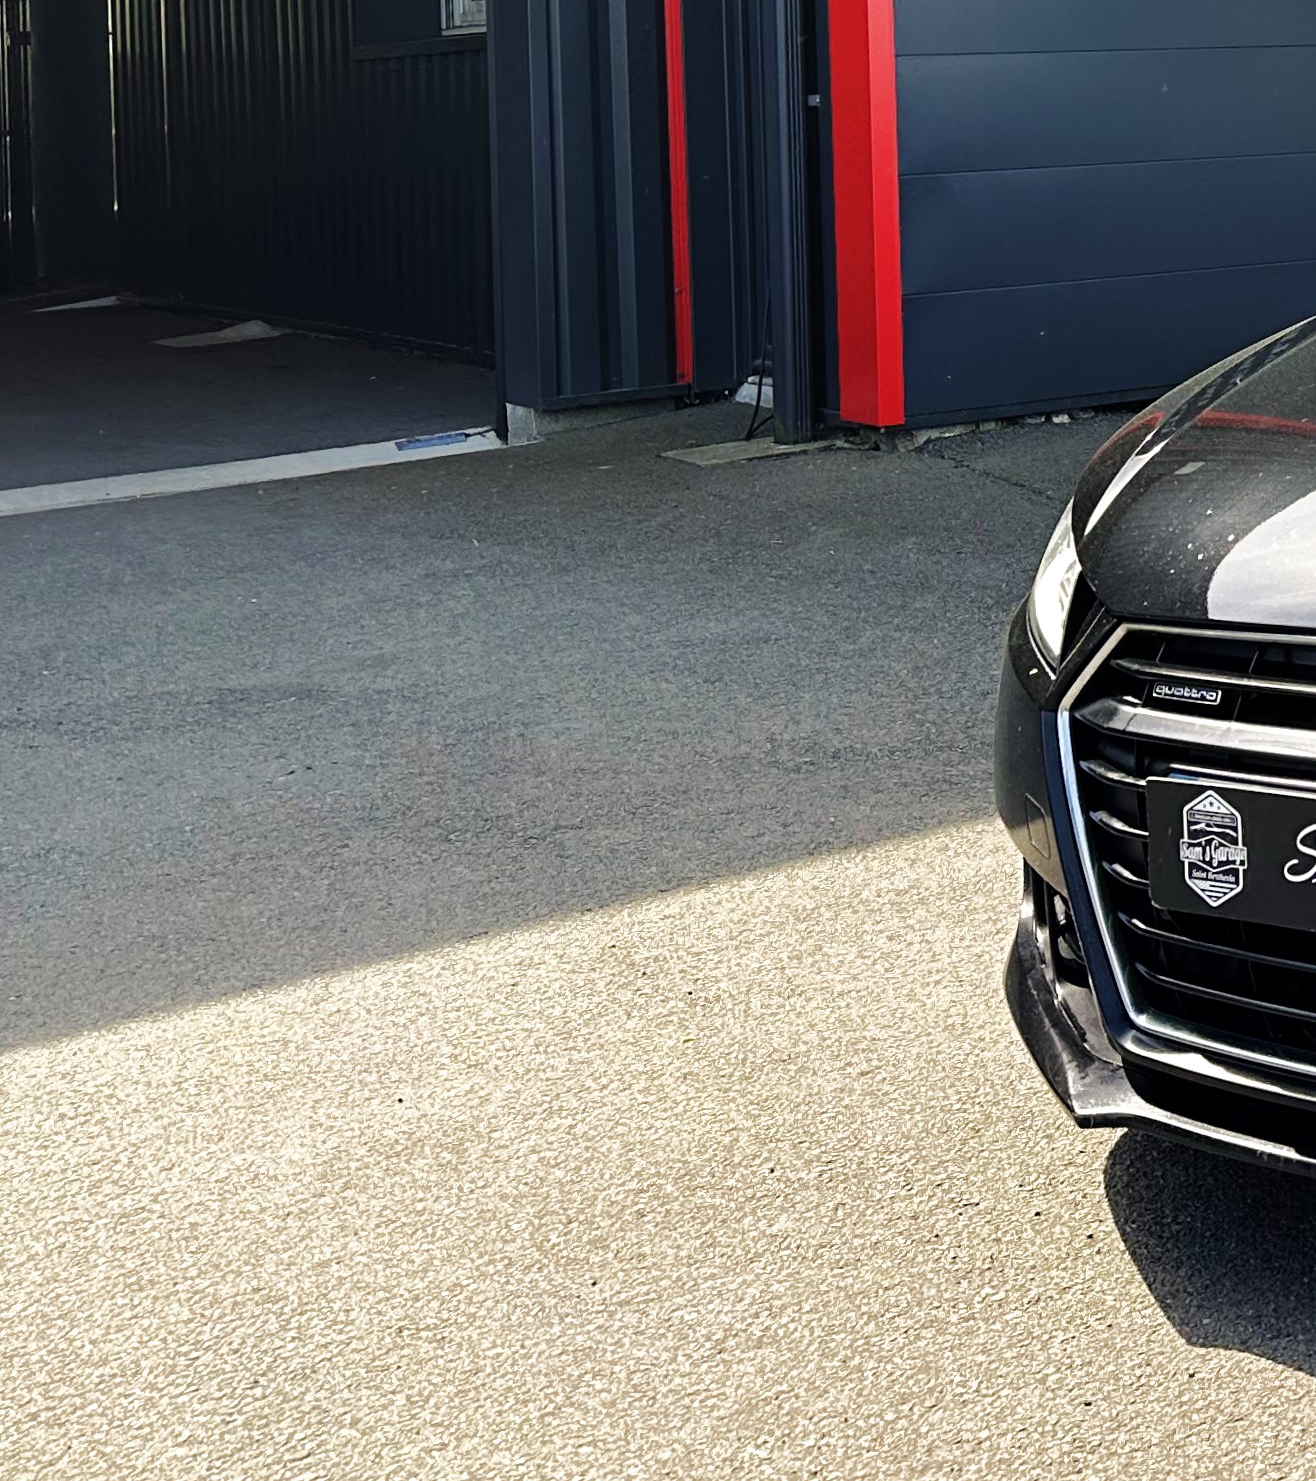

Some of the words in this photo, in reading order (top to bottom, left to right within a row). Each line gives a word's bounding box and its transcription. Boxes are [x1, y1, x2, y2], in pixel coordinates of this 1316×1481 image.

[1155, 684, 1217, 701] quattro
[1182, 841, 1210, 862] Sam's
[1210, 840, 1246, 867] Garage
